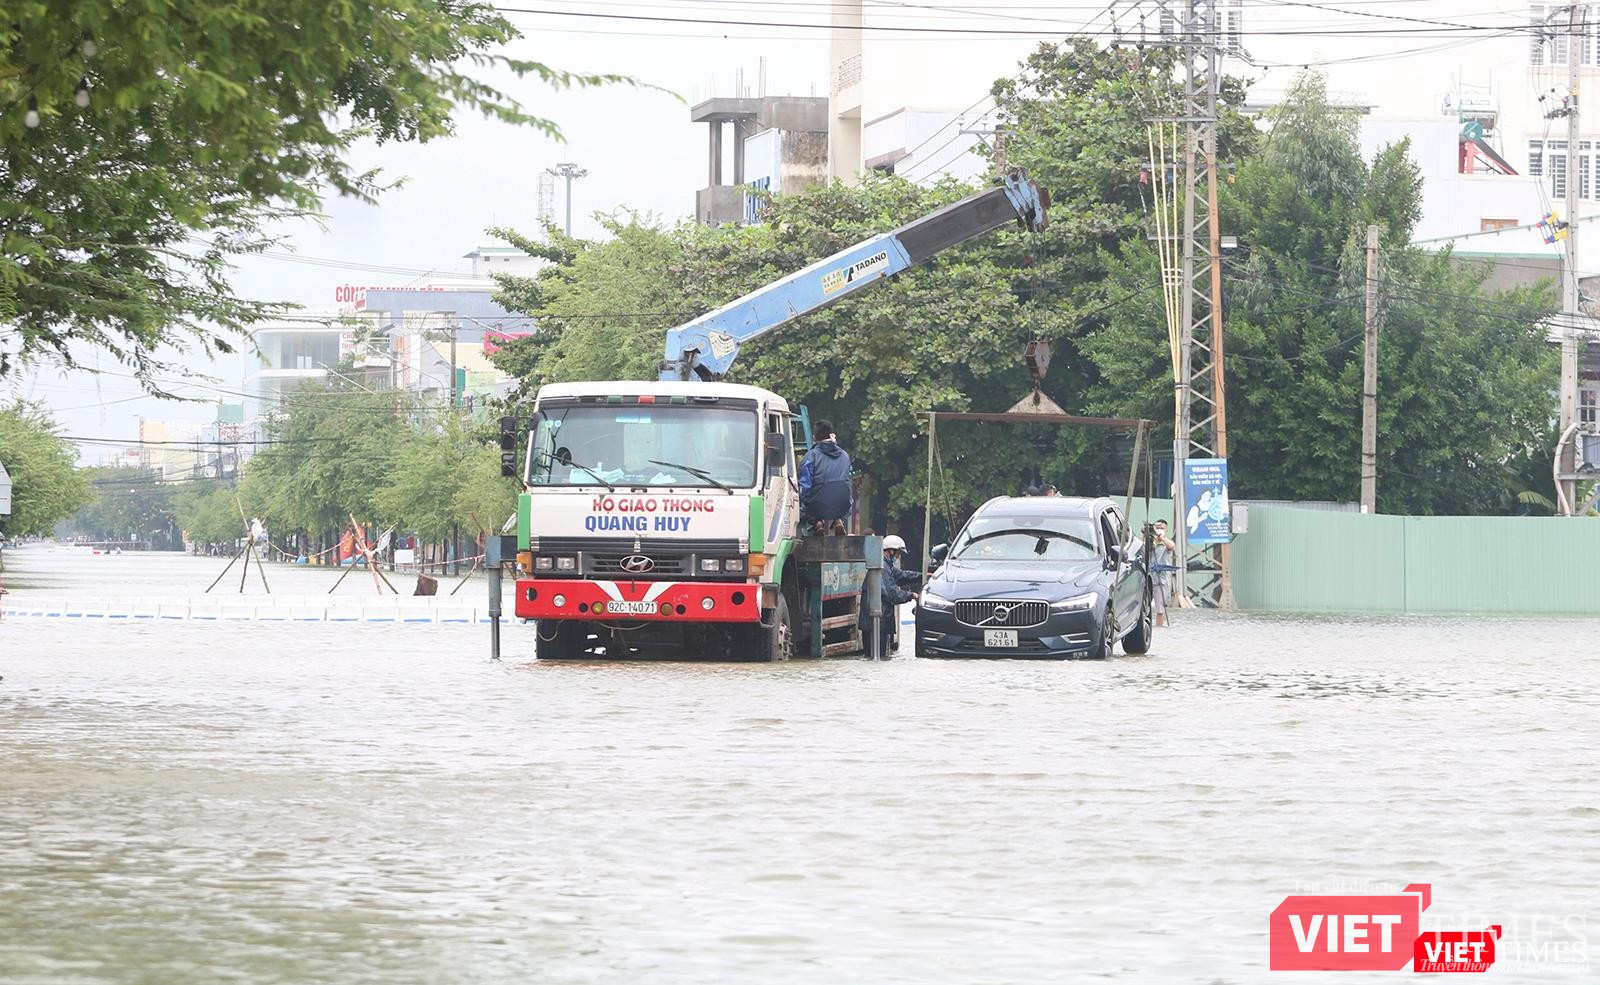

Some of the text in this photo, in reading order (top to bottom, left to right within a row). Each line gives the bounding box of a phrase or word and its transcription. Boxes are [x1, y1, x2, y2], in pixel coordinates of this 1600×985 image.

[855, 252, 887, 272] TADANO
[335, 283, 366, 303] CÔN
[618, 499, 657, 512] GIAO
[585, 516, 691, 532] QUANG HUY
[993, 631, 1009, 639] 43A
